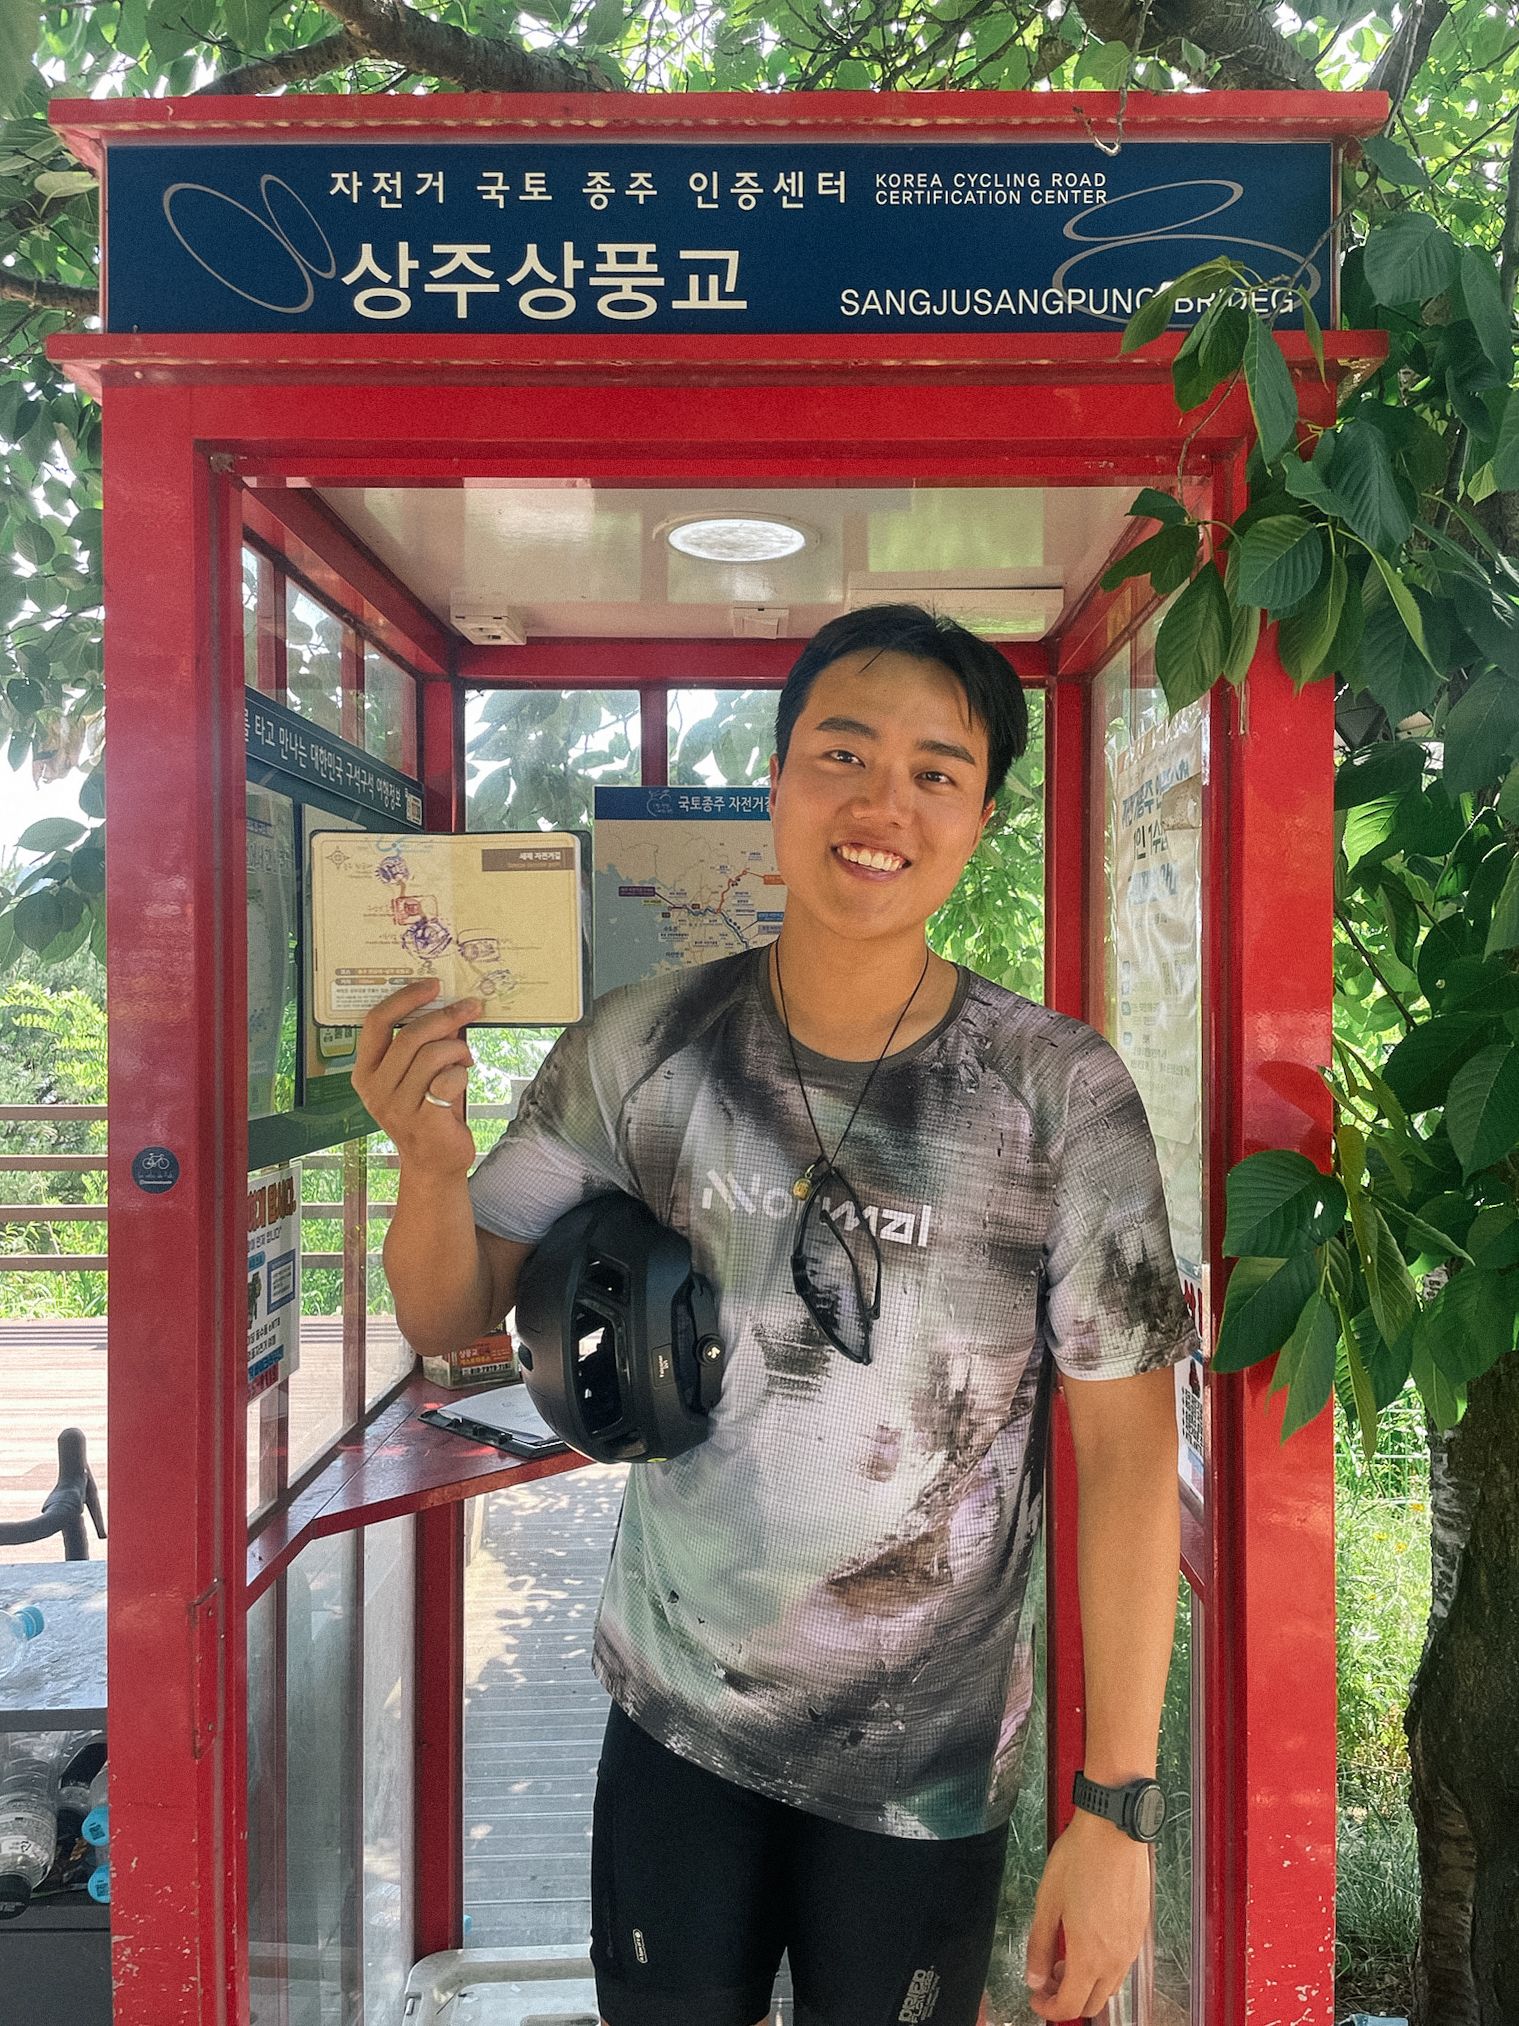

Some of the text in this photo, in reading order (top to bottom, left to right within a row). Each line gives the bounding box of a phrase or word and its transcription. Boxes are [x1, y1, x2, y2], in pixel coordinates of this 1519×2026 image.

[329, 170, 846, 210] 자전거 국토 종주 인증센터
[876, 173, 1107, 188] KOREA CYCLING ROAD
[875, 189, 1108, 205] CERTIFICATION CENTER
[341, 241, 748, 320] 상주상풍교
[254, 714, 276, 747] 타고
[278, 728, 308, 769] 만나는
[310, 743, 344, 786] 대한민국
[345, 761, 375, 800] 구석구석
[376, 777, 402, 811] 여행정보
[678, 796, 726, 813] 국토종주
